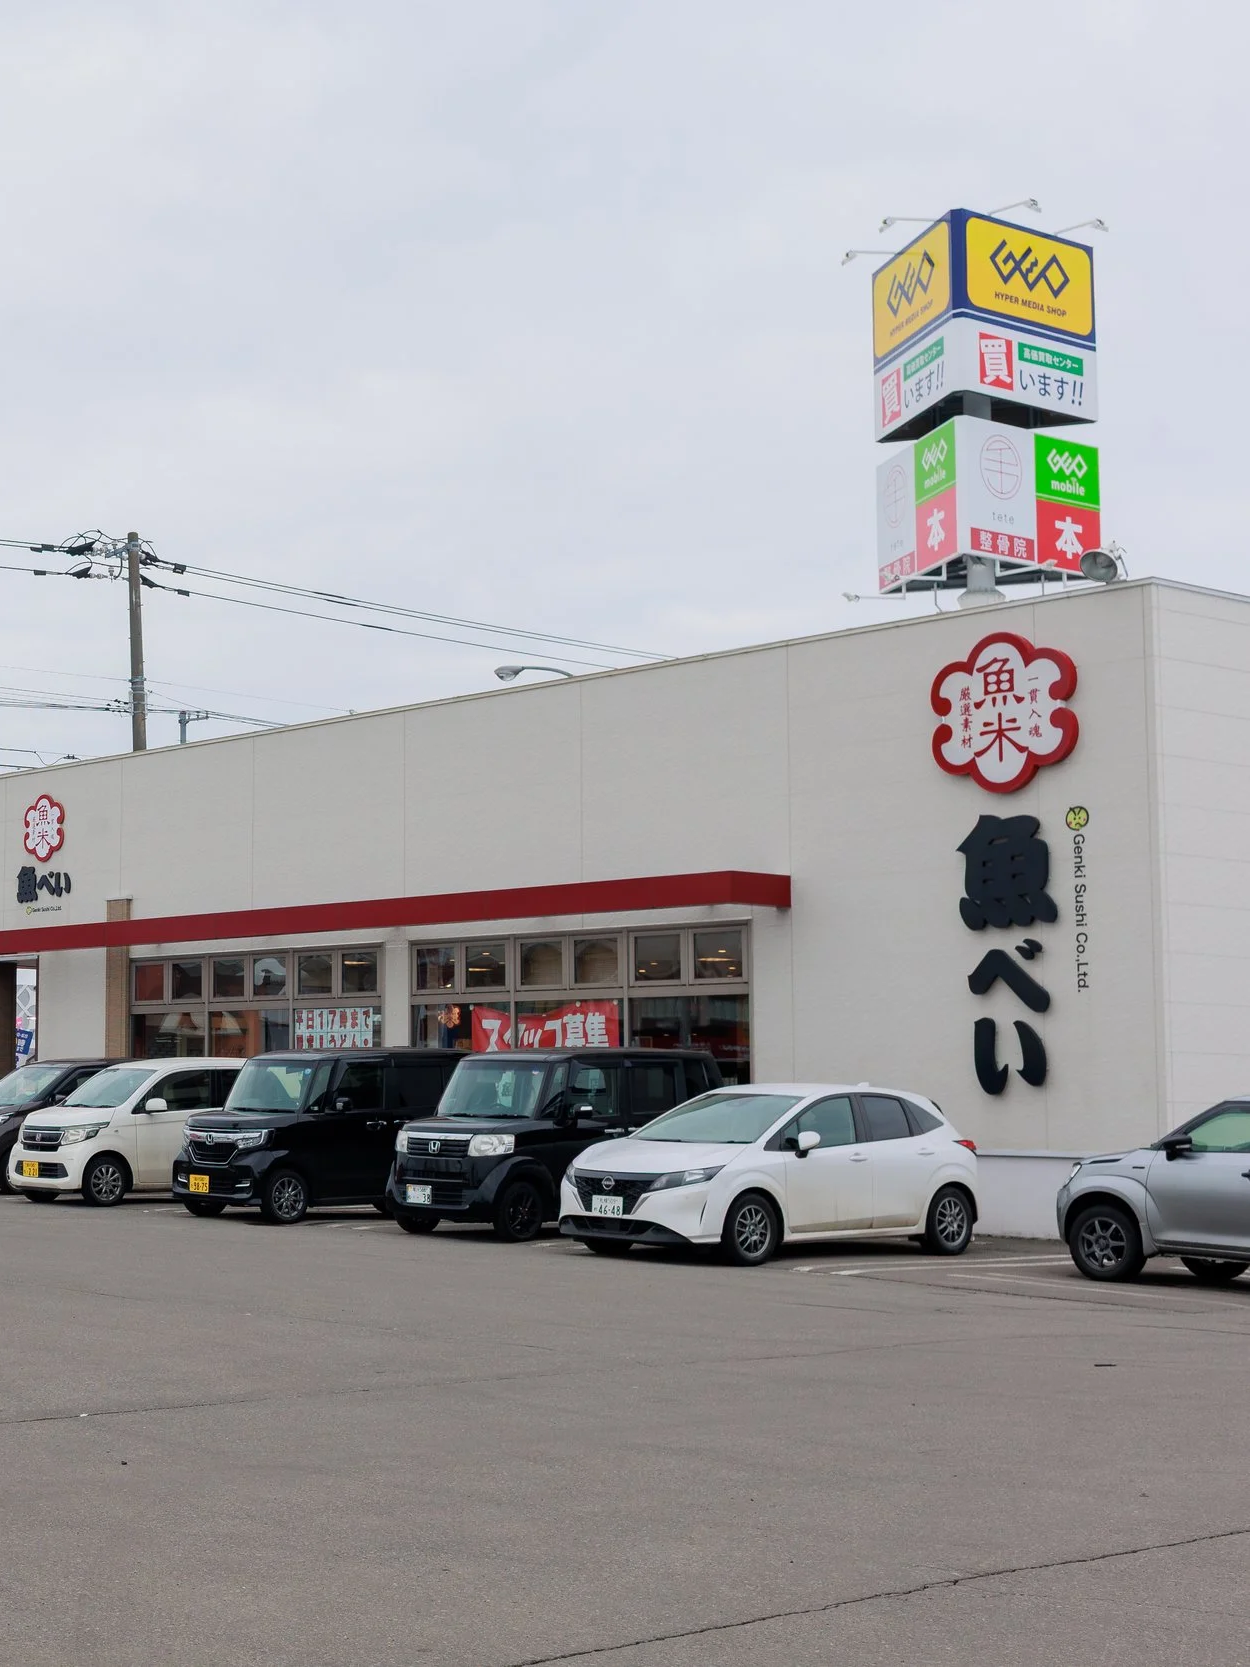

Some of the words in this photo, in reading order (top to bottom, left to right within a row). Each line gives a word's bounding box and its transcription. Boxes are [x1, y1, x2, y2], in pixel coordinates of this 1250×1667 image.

[994, 291, 1019, 305] HYPER
[1021, 298, 1044, 312] MEDIA
[1046, 305, 1067, 318] SHOP
[980, 338, 1012, 384] 買
[923, 466, 946, 490] mobile
[1050, 478, 1086, 497] mobile
[926, 507, 946, 551] 本
[992, 511, 1015, 525] tete
[1054, 516, 1084, 560] 本
[979, 530, 1027, 558] 整骨院
[973, 656, 1029, 763] 魚米
[1072, 833, 1086, 880] Genki
[1074, 882, 1088, 928] Sushi
[955, 814, 1058, 1096] 魚べい
[1075, 932, 1090, 993] Co.,Ltd.
[598, 1203, 621, 1216] 46-48
